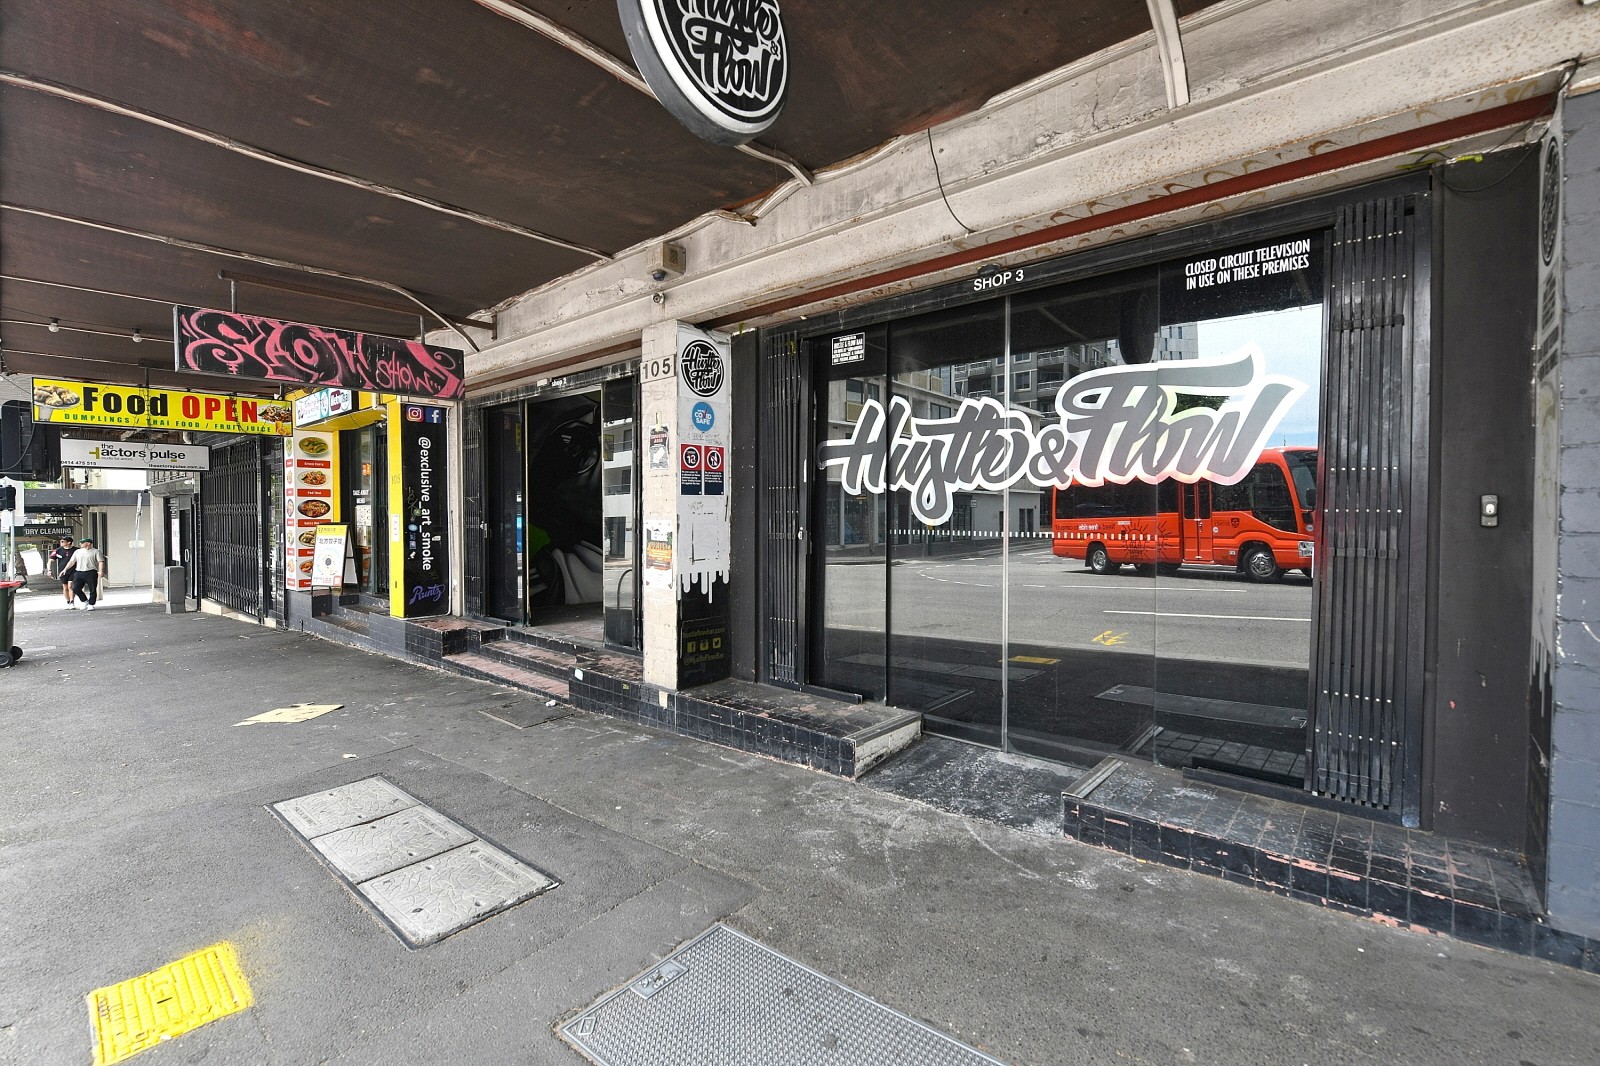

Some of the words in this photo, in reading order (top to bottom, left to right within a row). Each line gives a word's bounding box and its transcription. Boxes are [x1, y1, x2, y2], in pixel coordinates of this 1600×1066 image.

[1185, 259, 1216, 277] CLOSED
[1219, 250, 1255, 270] CIRCUIT
[1255, 239, 1311, 263] TELEVISION
[973, 271, 1012, 291] SHOP
[1015, 269, 1024, 282] 3
[1186, 276, 1197, 290] IN
[1198, 272, 1215, 288] USE
[1216, 269, 1231, 285] ON
[1232, 264, 1260, 281] THESE
[1262, 254, 1310, 276] PREMISES
[642, 357, 671, 380] 105
[82, 386, 169, 417] Food
[181, 395, 258, 424] OPEN
[64, 413, 131, 424] DUMPLINGS
[146, 418, 170, 426] THAI
[214, 423, 241, 431] FRUIT
[245, 425, 272, 433] JUICE
[695, 417, 711, 425] SAFE
[817, 395, 1034, 526] Hustle
[1027, 424, 1078, 491] &
[1055, 344, 1310, 489] Flow
[101, 448, 147, 458] actors
[150, 449, 186, 462] pulse
[418, 436, 434, 571] @exclusive_art_smoke
[40, 527, 72, 535] CLEANING
